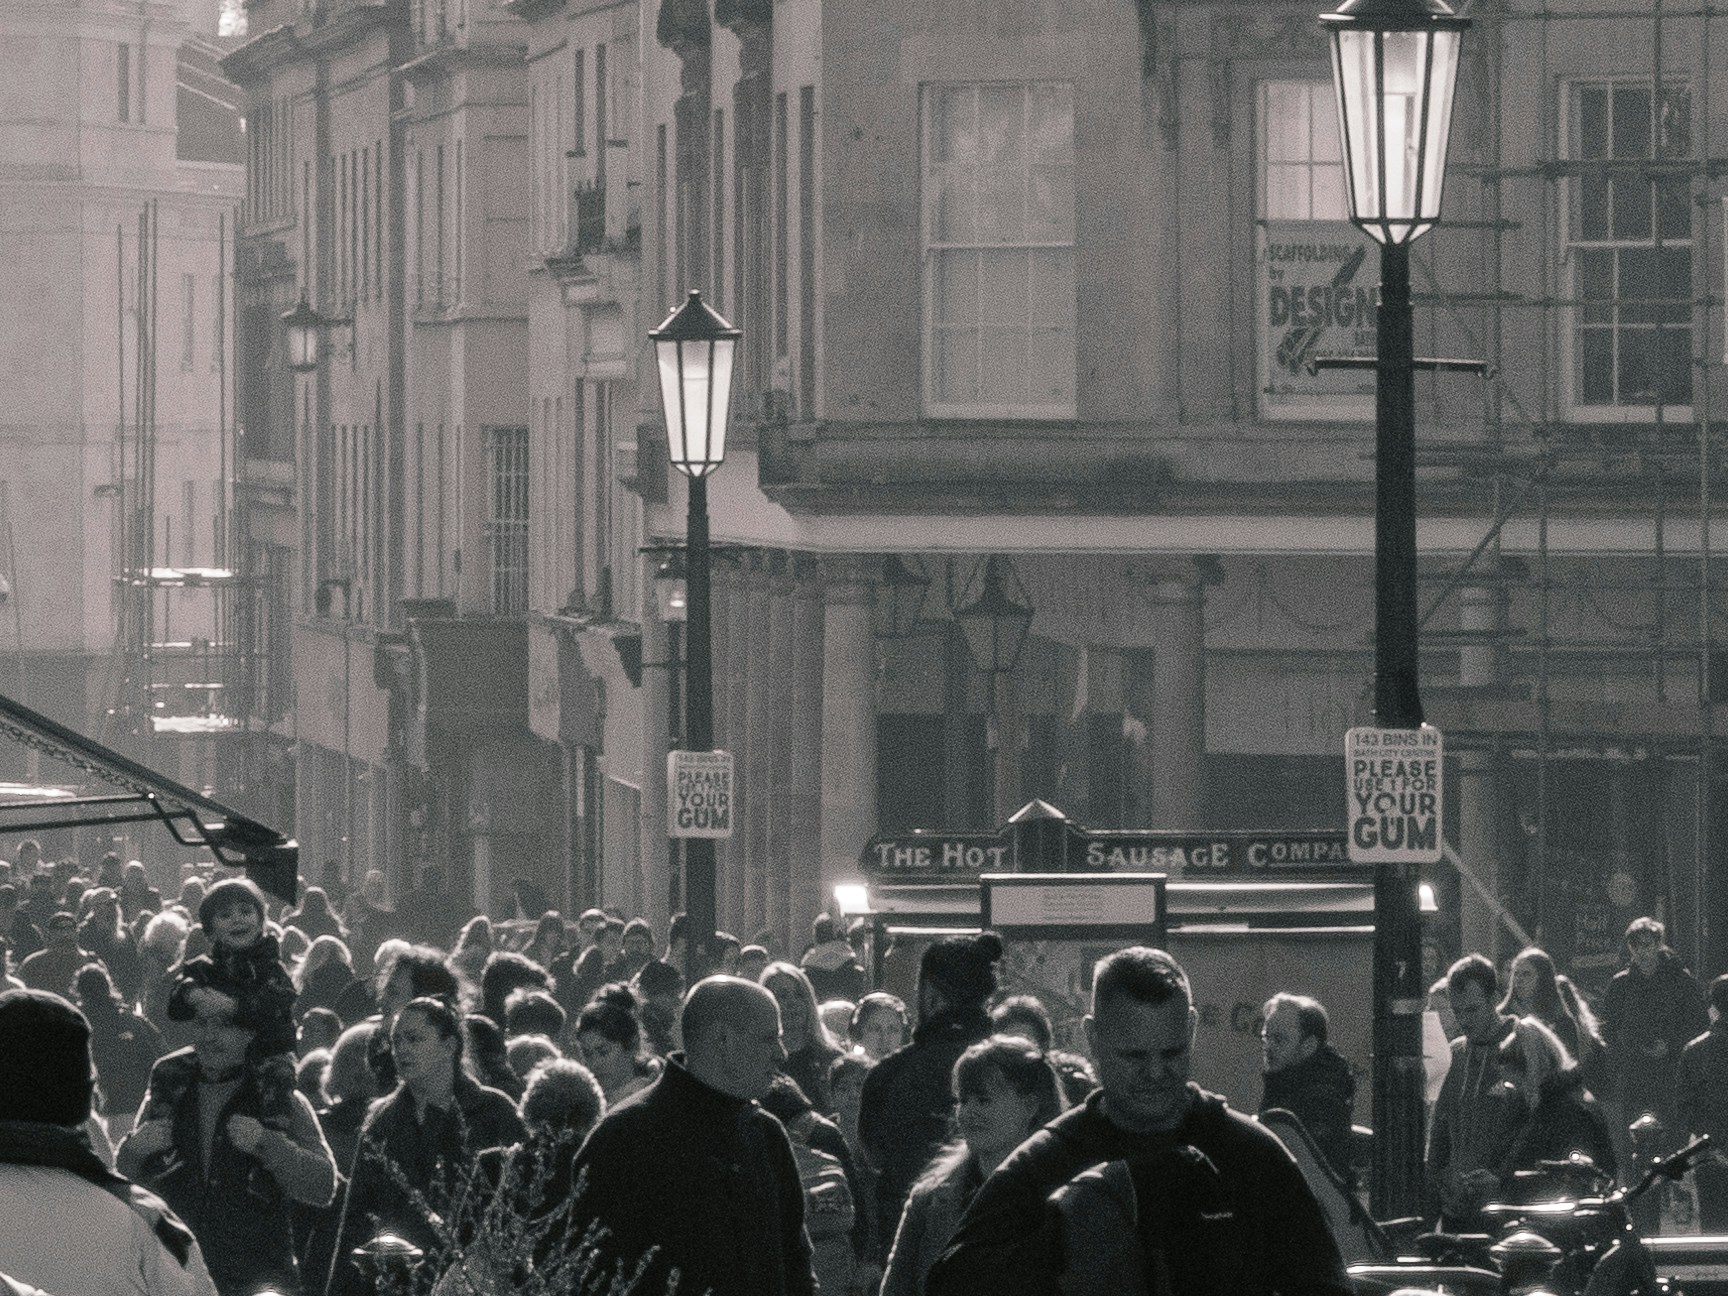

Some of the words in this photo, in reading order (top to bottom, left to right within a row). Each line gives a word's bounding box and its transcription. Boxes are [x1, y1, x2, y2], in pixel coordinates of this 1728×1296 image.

[1269, 244, 1352, 262] SCAFFOLDING
[1269, 265, 1284, 281] by
[1354, 733, 1379, 746] 143
[1383, 733, 1418, 746] BINS
[1422, 733, 1437, 746] IN
[1380, 748, 1398, 757] CITY
[1401, 748, 1436, 757] CENTRE
[678, 771, 729, 783] PLEASE
[1353, 760, 1436, 778] PLEASE
[1354, 778, 1384, 791] USE
[1390, 778, 1396, 791] 1
[1402, 778, 1436, 791] FOR
[678, 793, 729, 807] YOUR
[1355, 792, 1436, 815] YOUR
[678, 808, 729, 830] GUM
[1353, 816, 1436, 850] GUM
[873, 843, 931, 868] THE
[941, 843, 1008, 869] HOT
[1086, 842, 1230, 868] SAUSAGE
